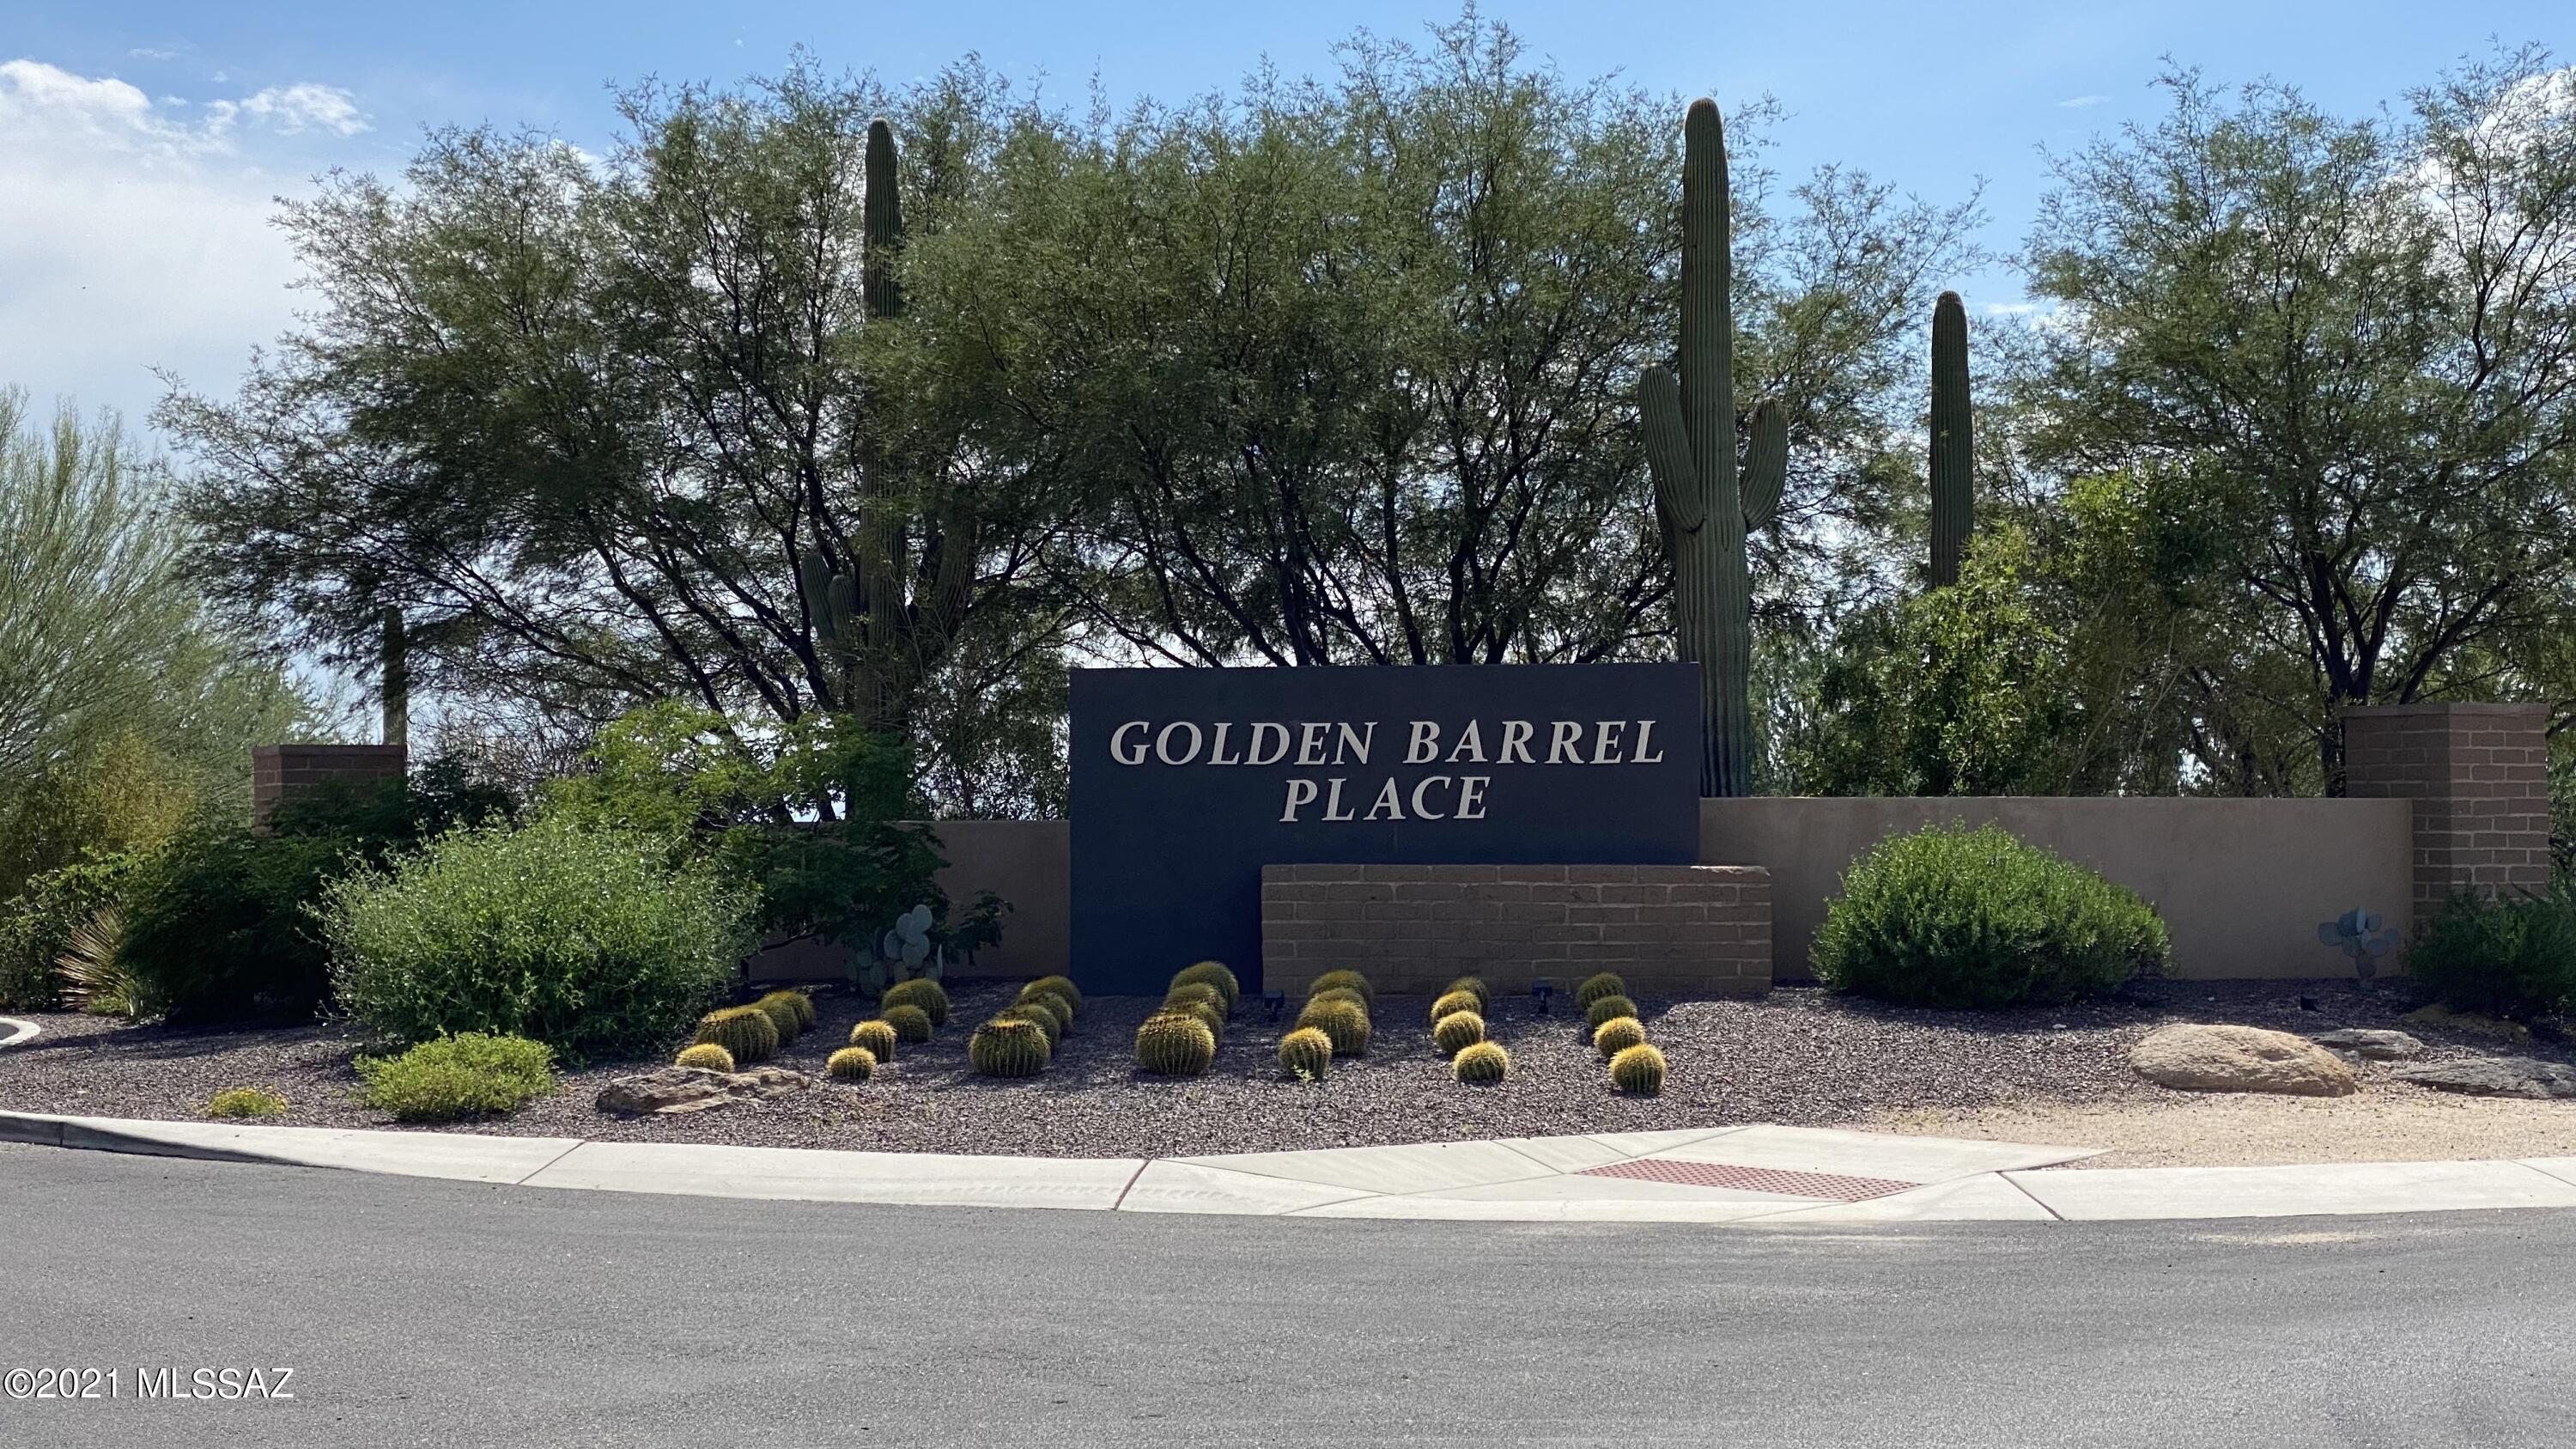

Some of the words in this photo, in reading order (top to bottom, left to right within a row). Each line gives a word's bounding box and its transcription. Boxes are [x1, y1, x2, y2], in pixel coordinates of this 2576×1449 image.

[1109, 720, 1379, 766] GOLDEN
[1401, 718, 1664, 764] BARREL
[1279, 776, 1492, 822] PLACE
